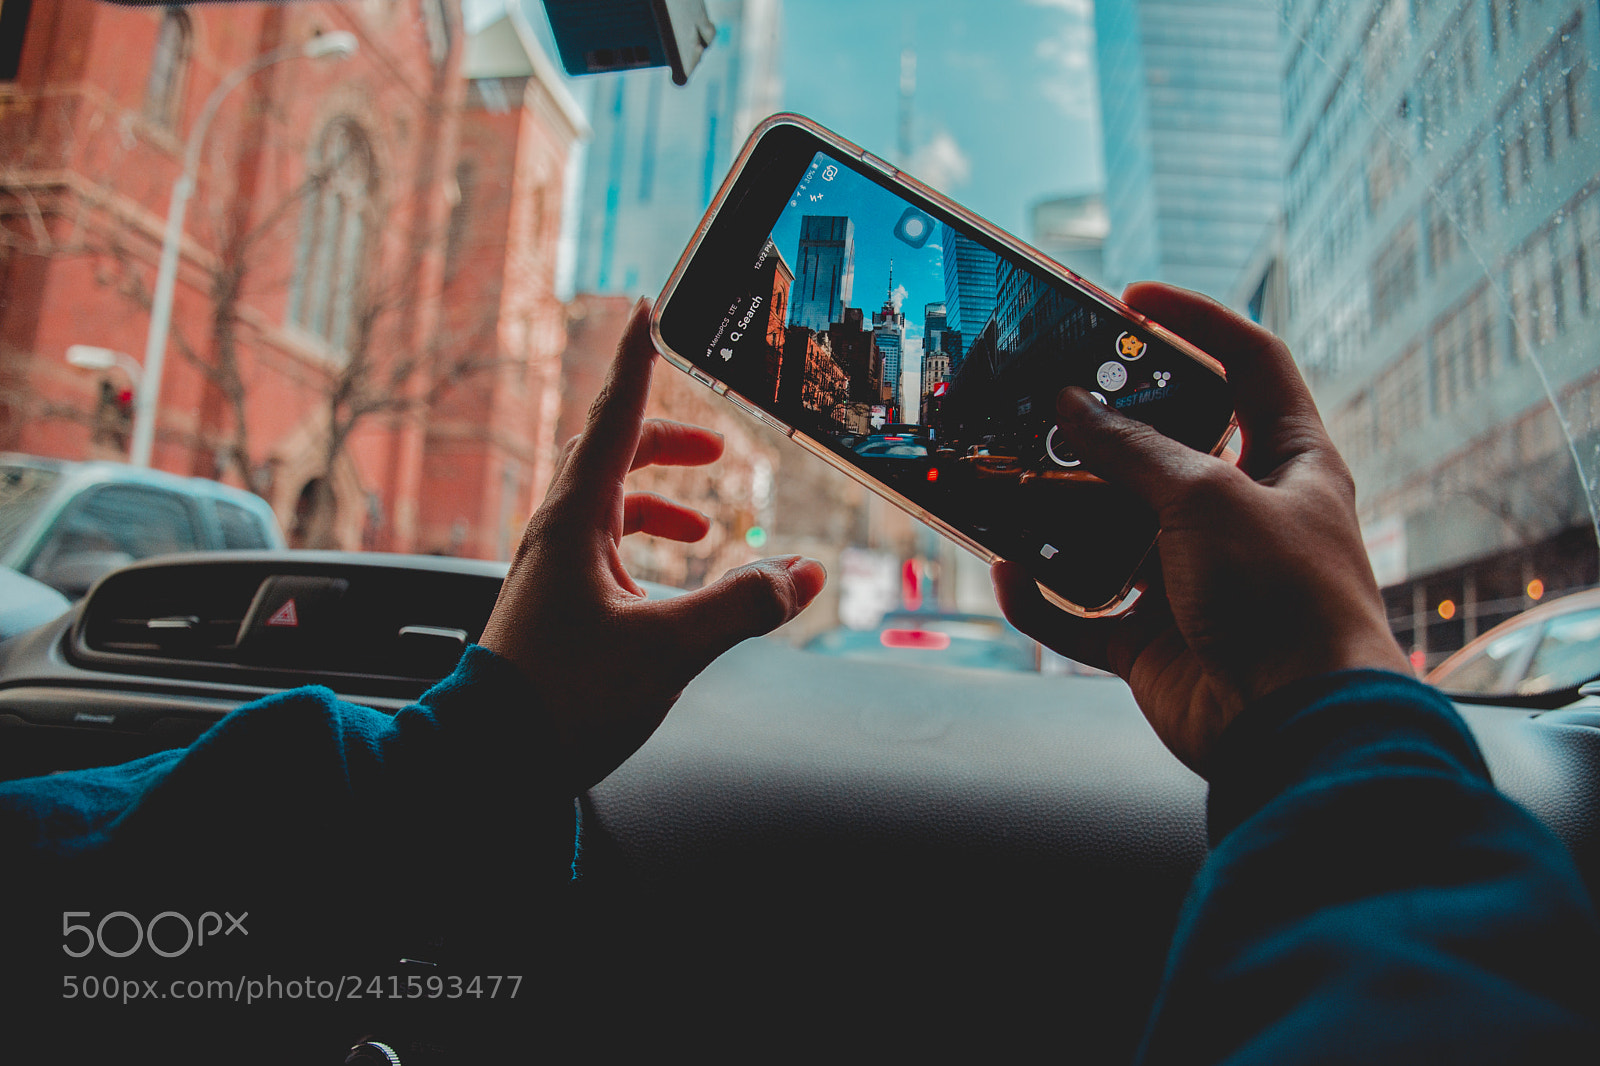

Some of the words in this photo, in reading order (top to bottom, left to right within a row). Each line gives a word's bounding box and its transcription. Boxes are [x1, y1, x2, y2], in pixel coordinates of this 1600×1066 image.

[804, 170, 816, 184] 30%
[754, 248, 769, 271] 12:02
[765, 240, 775, 254] PM
[710, 317, 730, 349] MetroPCS
[728, 303, 738, 316] LTE
[738, 295, 763, 330] Search
